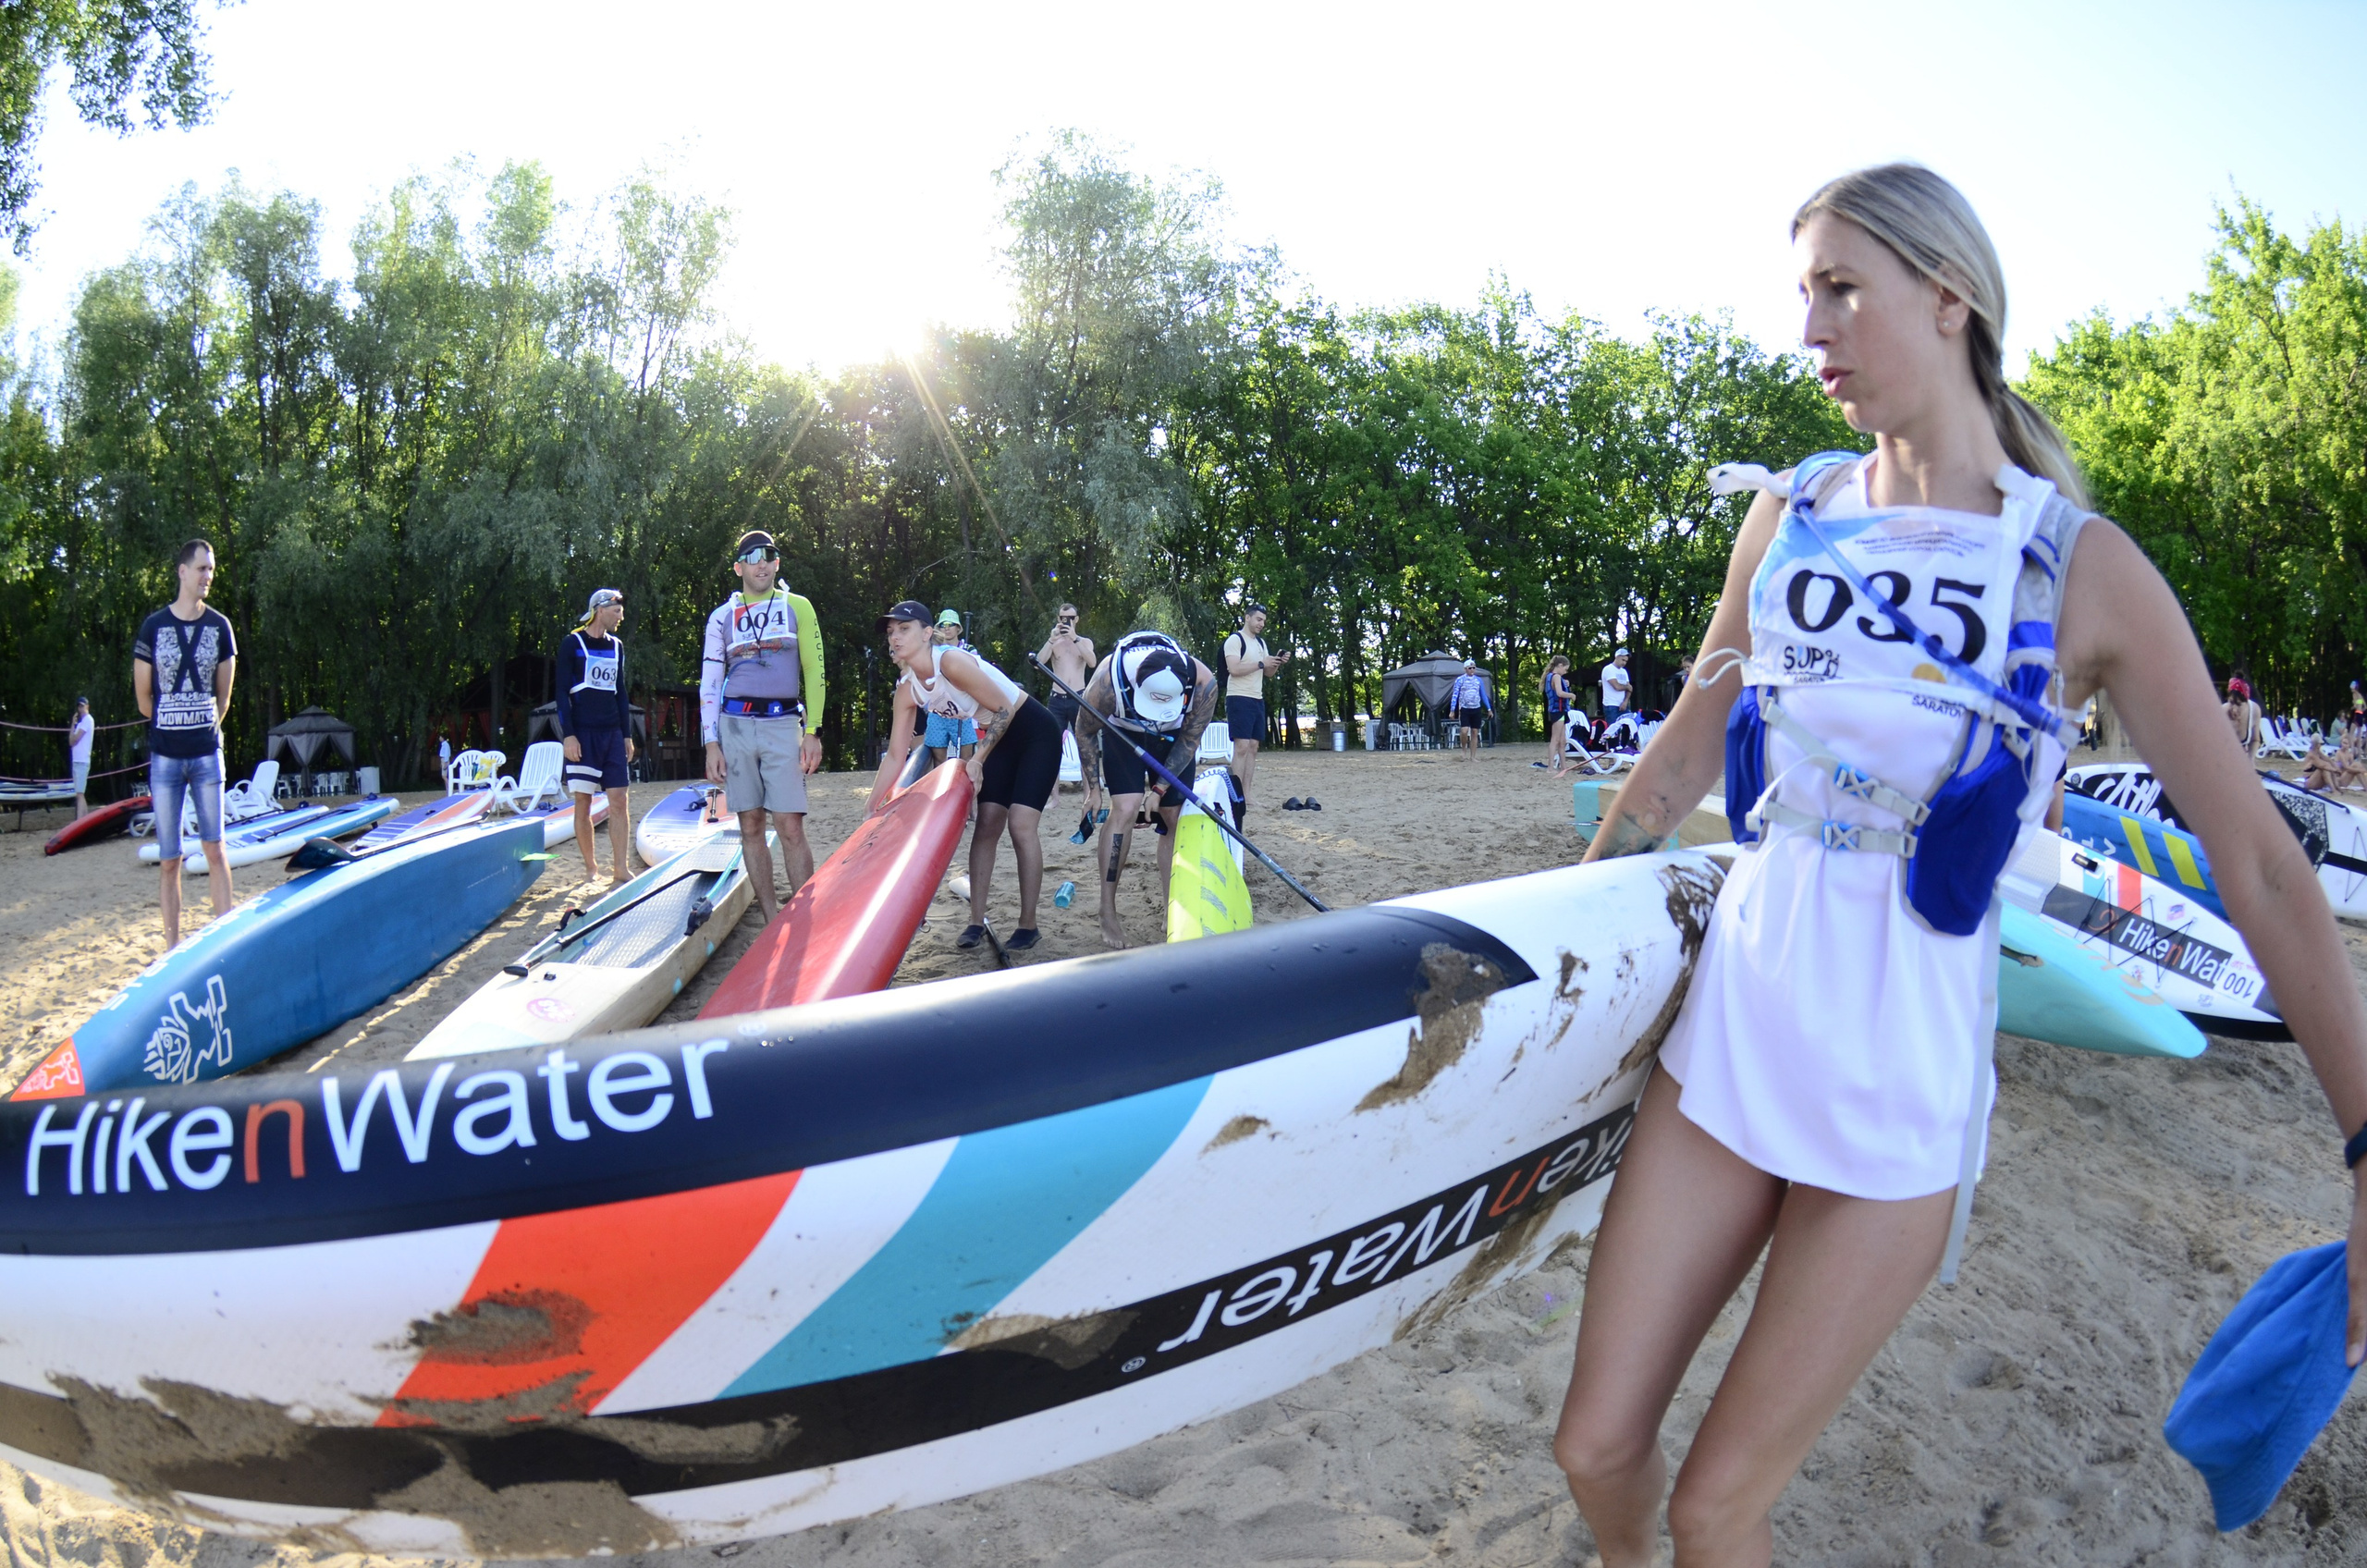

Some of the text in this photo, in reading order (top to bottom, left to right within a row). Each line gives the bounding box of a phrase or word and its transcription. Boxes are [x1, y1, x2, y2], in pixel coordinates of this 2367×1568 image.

[737, 610, 786, 632] 004
[1786, 569, 1986, 666] 035
[592, 667, 617, 681] 063
[25, 1038, 730, 1196] HikenWater
[1158, 1116, 1635, 1352] ikenWater
